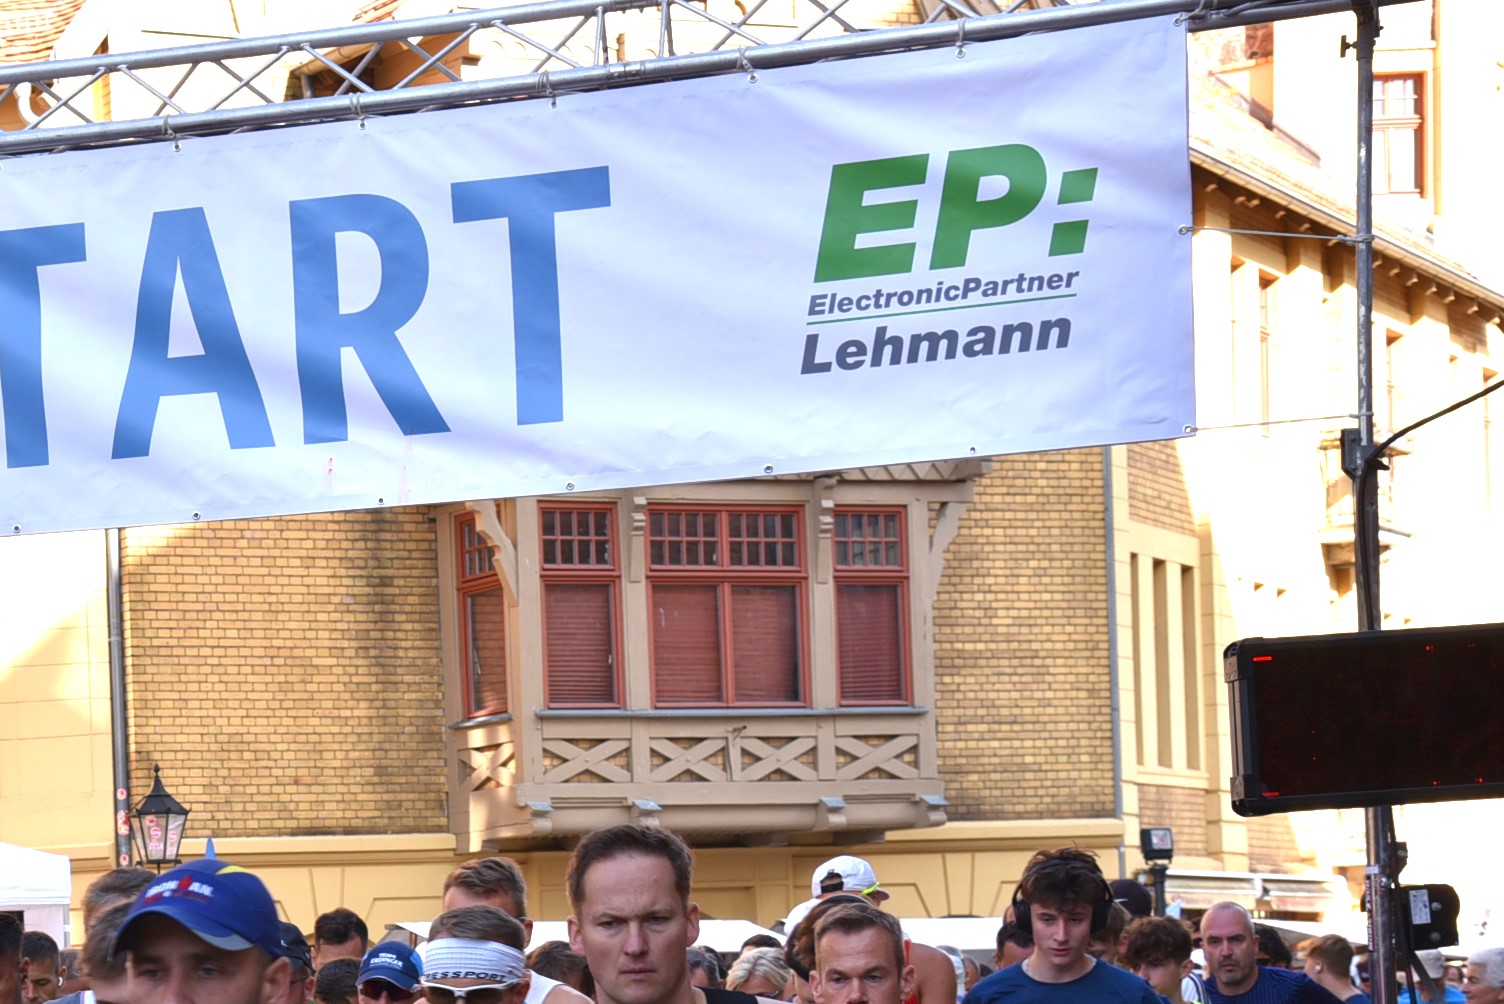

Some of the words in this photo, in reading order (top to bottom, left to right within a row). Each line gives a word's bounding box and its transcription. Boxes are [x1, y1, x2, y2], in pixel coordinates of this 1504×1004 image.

[813, 143, 1098, 283] EP:
[807, 271, 1080, 316] ElectronicPartner
[800, 317, 1072, 375] Lehmann
